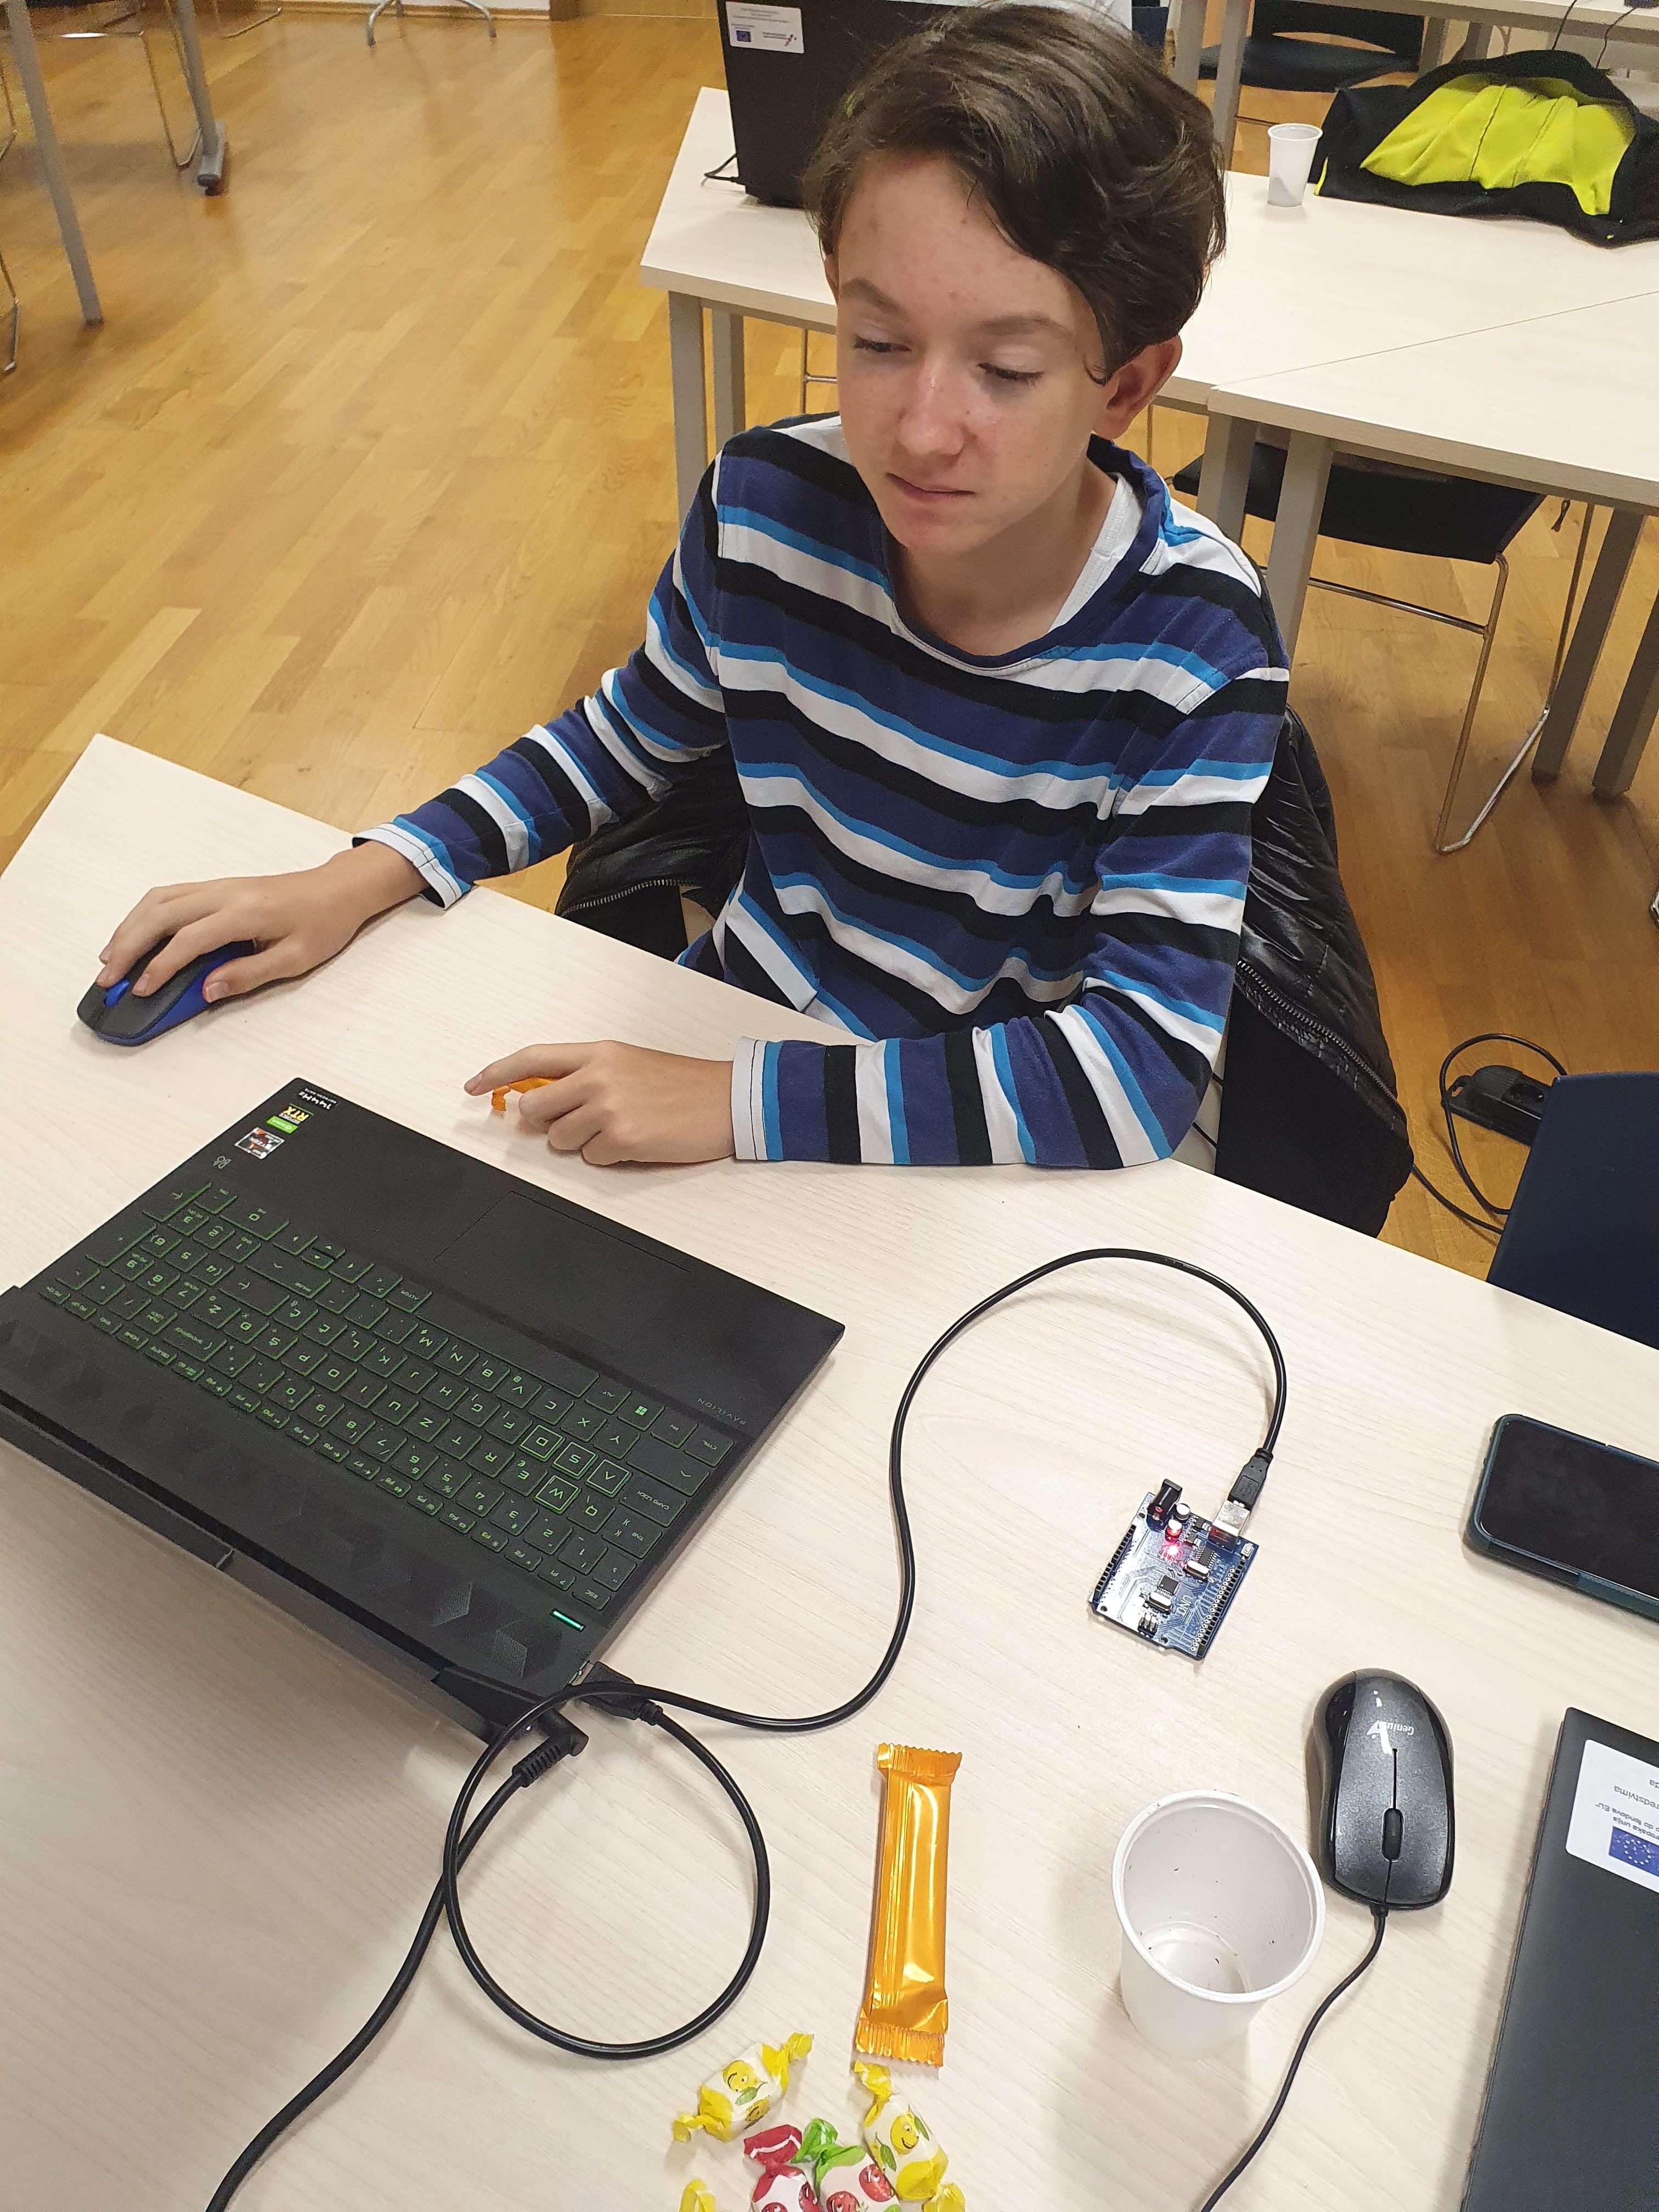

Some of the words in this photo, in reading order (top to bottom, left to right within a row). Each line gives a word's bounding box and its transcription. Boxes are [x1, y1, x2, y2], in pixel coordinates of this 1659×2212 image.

[283, 1106, 309, 1121] RTX
[419, 1338, 433, 1346] M
[379, 1356, 390, 1364] K
[450, 1352, 462, 1361] N
[482, 1369, 493, 1377] B
[440, 1387, 452, 1396] H
[389, 1401, 400, 1410] U
[698, 1398, 746, 1424] PAVILION
[420, 1418, 433, 1427] Z
[578, 1418, 590, 1426] X
[452, 1436, 461, 1444] T
[536, 1437, 549, 1446] D
[610, 1436, 619, 1444] Y
[486, 1453, 497, 1462] R
[569, 1454, 580, 1463] S
[518, 1470, 529, 1479] E
[549, 1488, 563, 1499] W
[585, 1505, 597, 1516] Q
[1177, 1595, 1192, 1615] UNO
[1383, 1722, 1414, 1736] Geniu
[1612, 1808, 1641, 1825] fondova
[1613, 1817, 1630, 1827] unija
[1633, 1825, 1659, 1839] ropska
